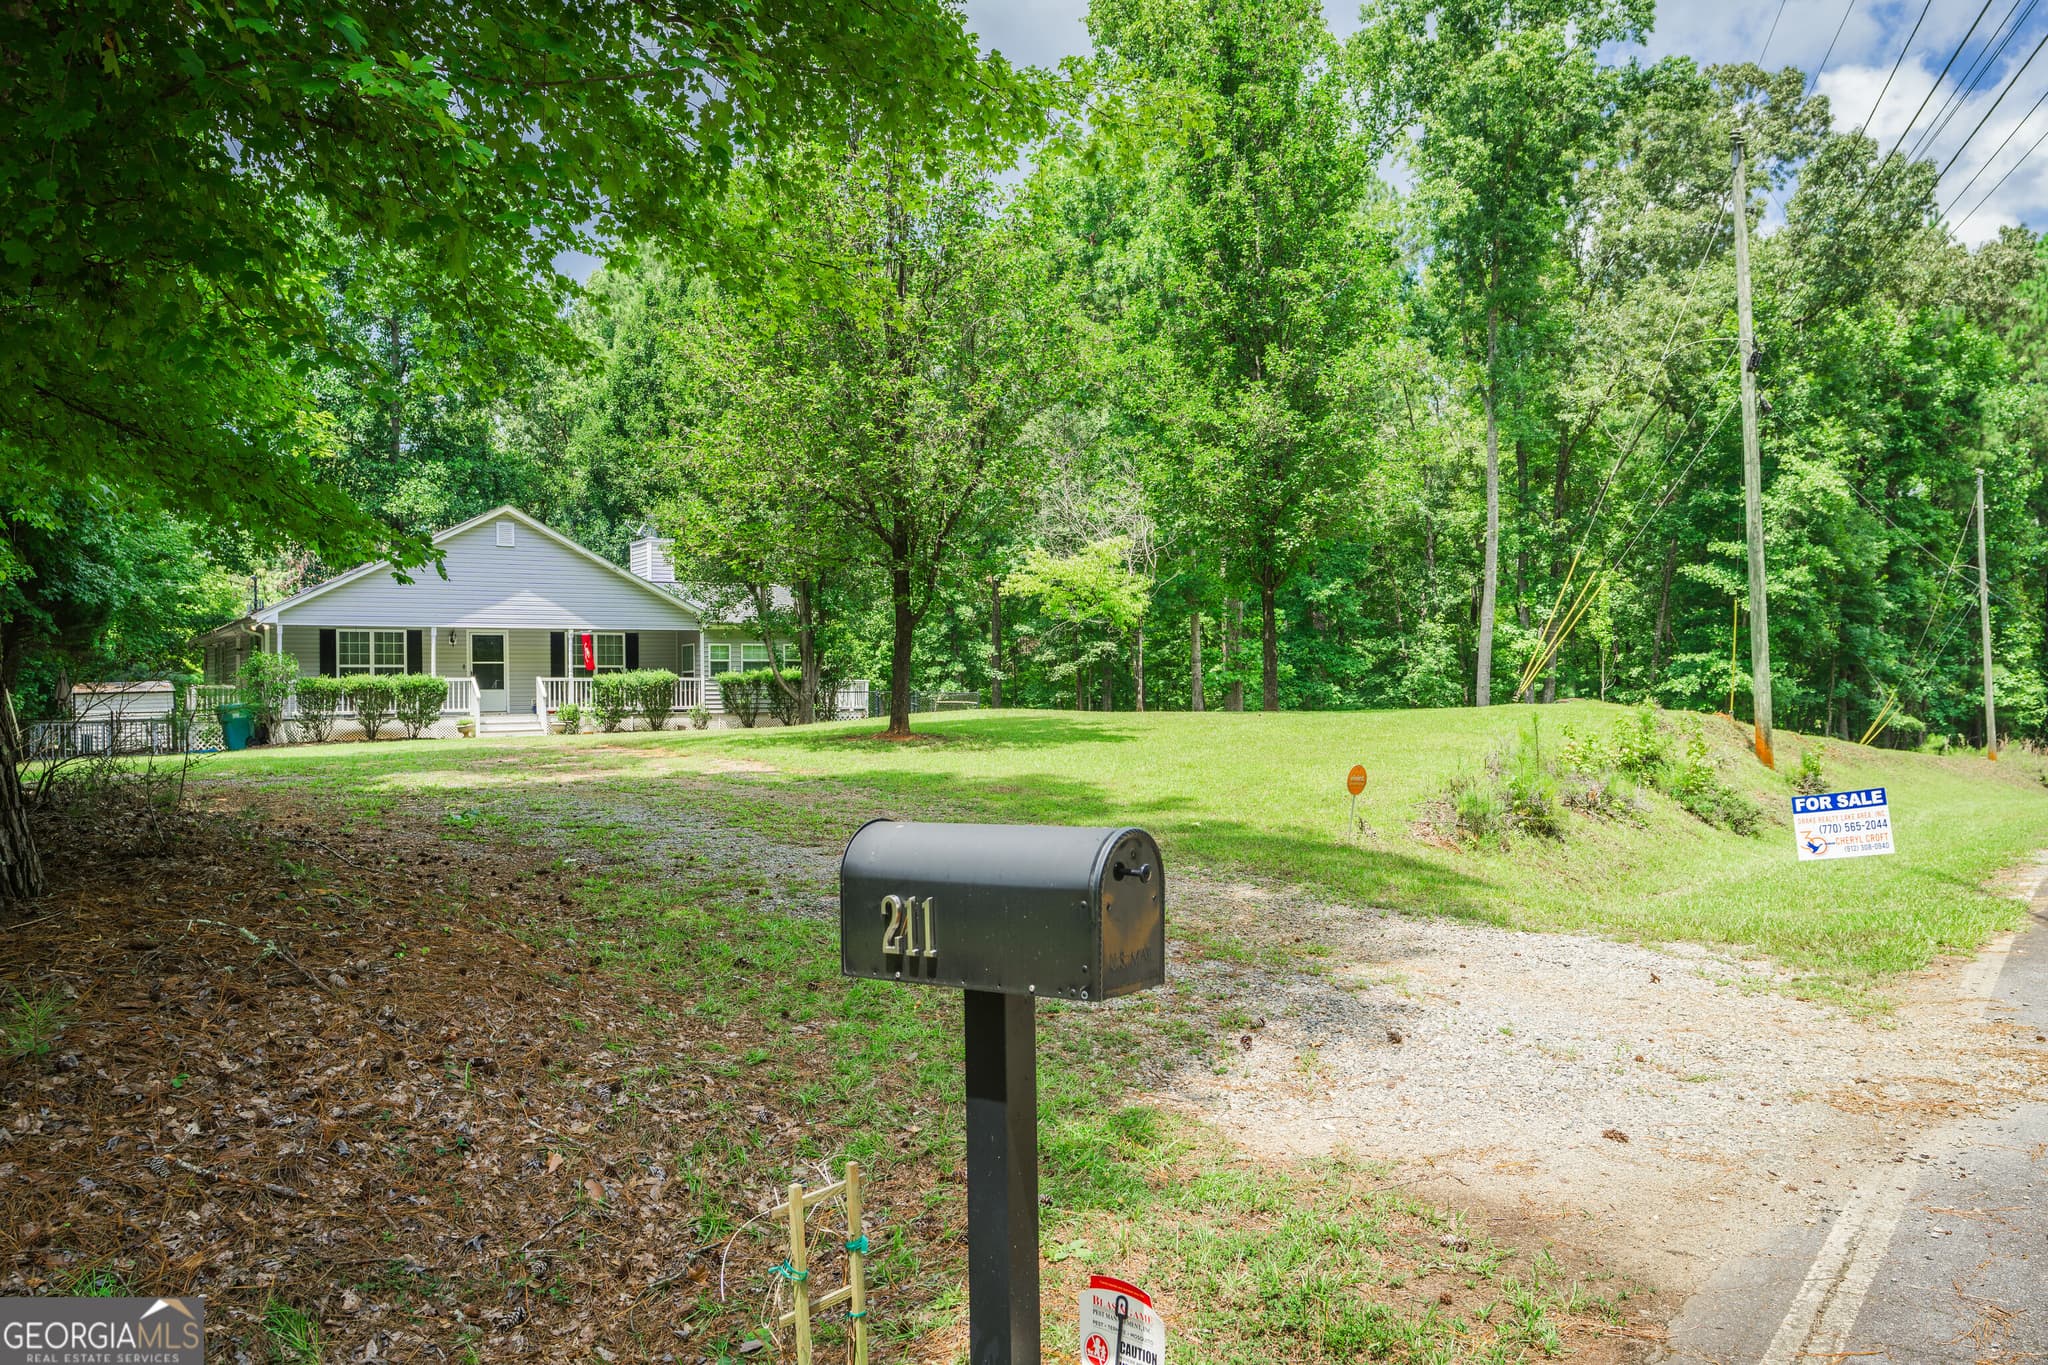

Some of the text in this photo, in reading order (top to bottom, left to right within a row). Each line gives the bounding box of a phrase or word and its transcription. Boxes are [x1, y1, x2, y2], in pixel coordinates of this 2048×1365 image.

[1795, 790, 1883, 812] FOR SALE
[1818, 814, 1839, 823] REALTY
[1841, 813, 1855, 821] LAKE
[1819, 819, 1888, 834] (770) 565-2044
[1835, 836, 1864, 845] CHERYL
[1865, 833, 1888, 842] CROFT
[881, 894, 937, 957] 211
[1120, 1341, 1158, 1365] CAUTION
